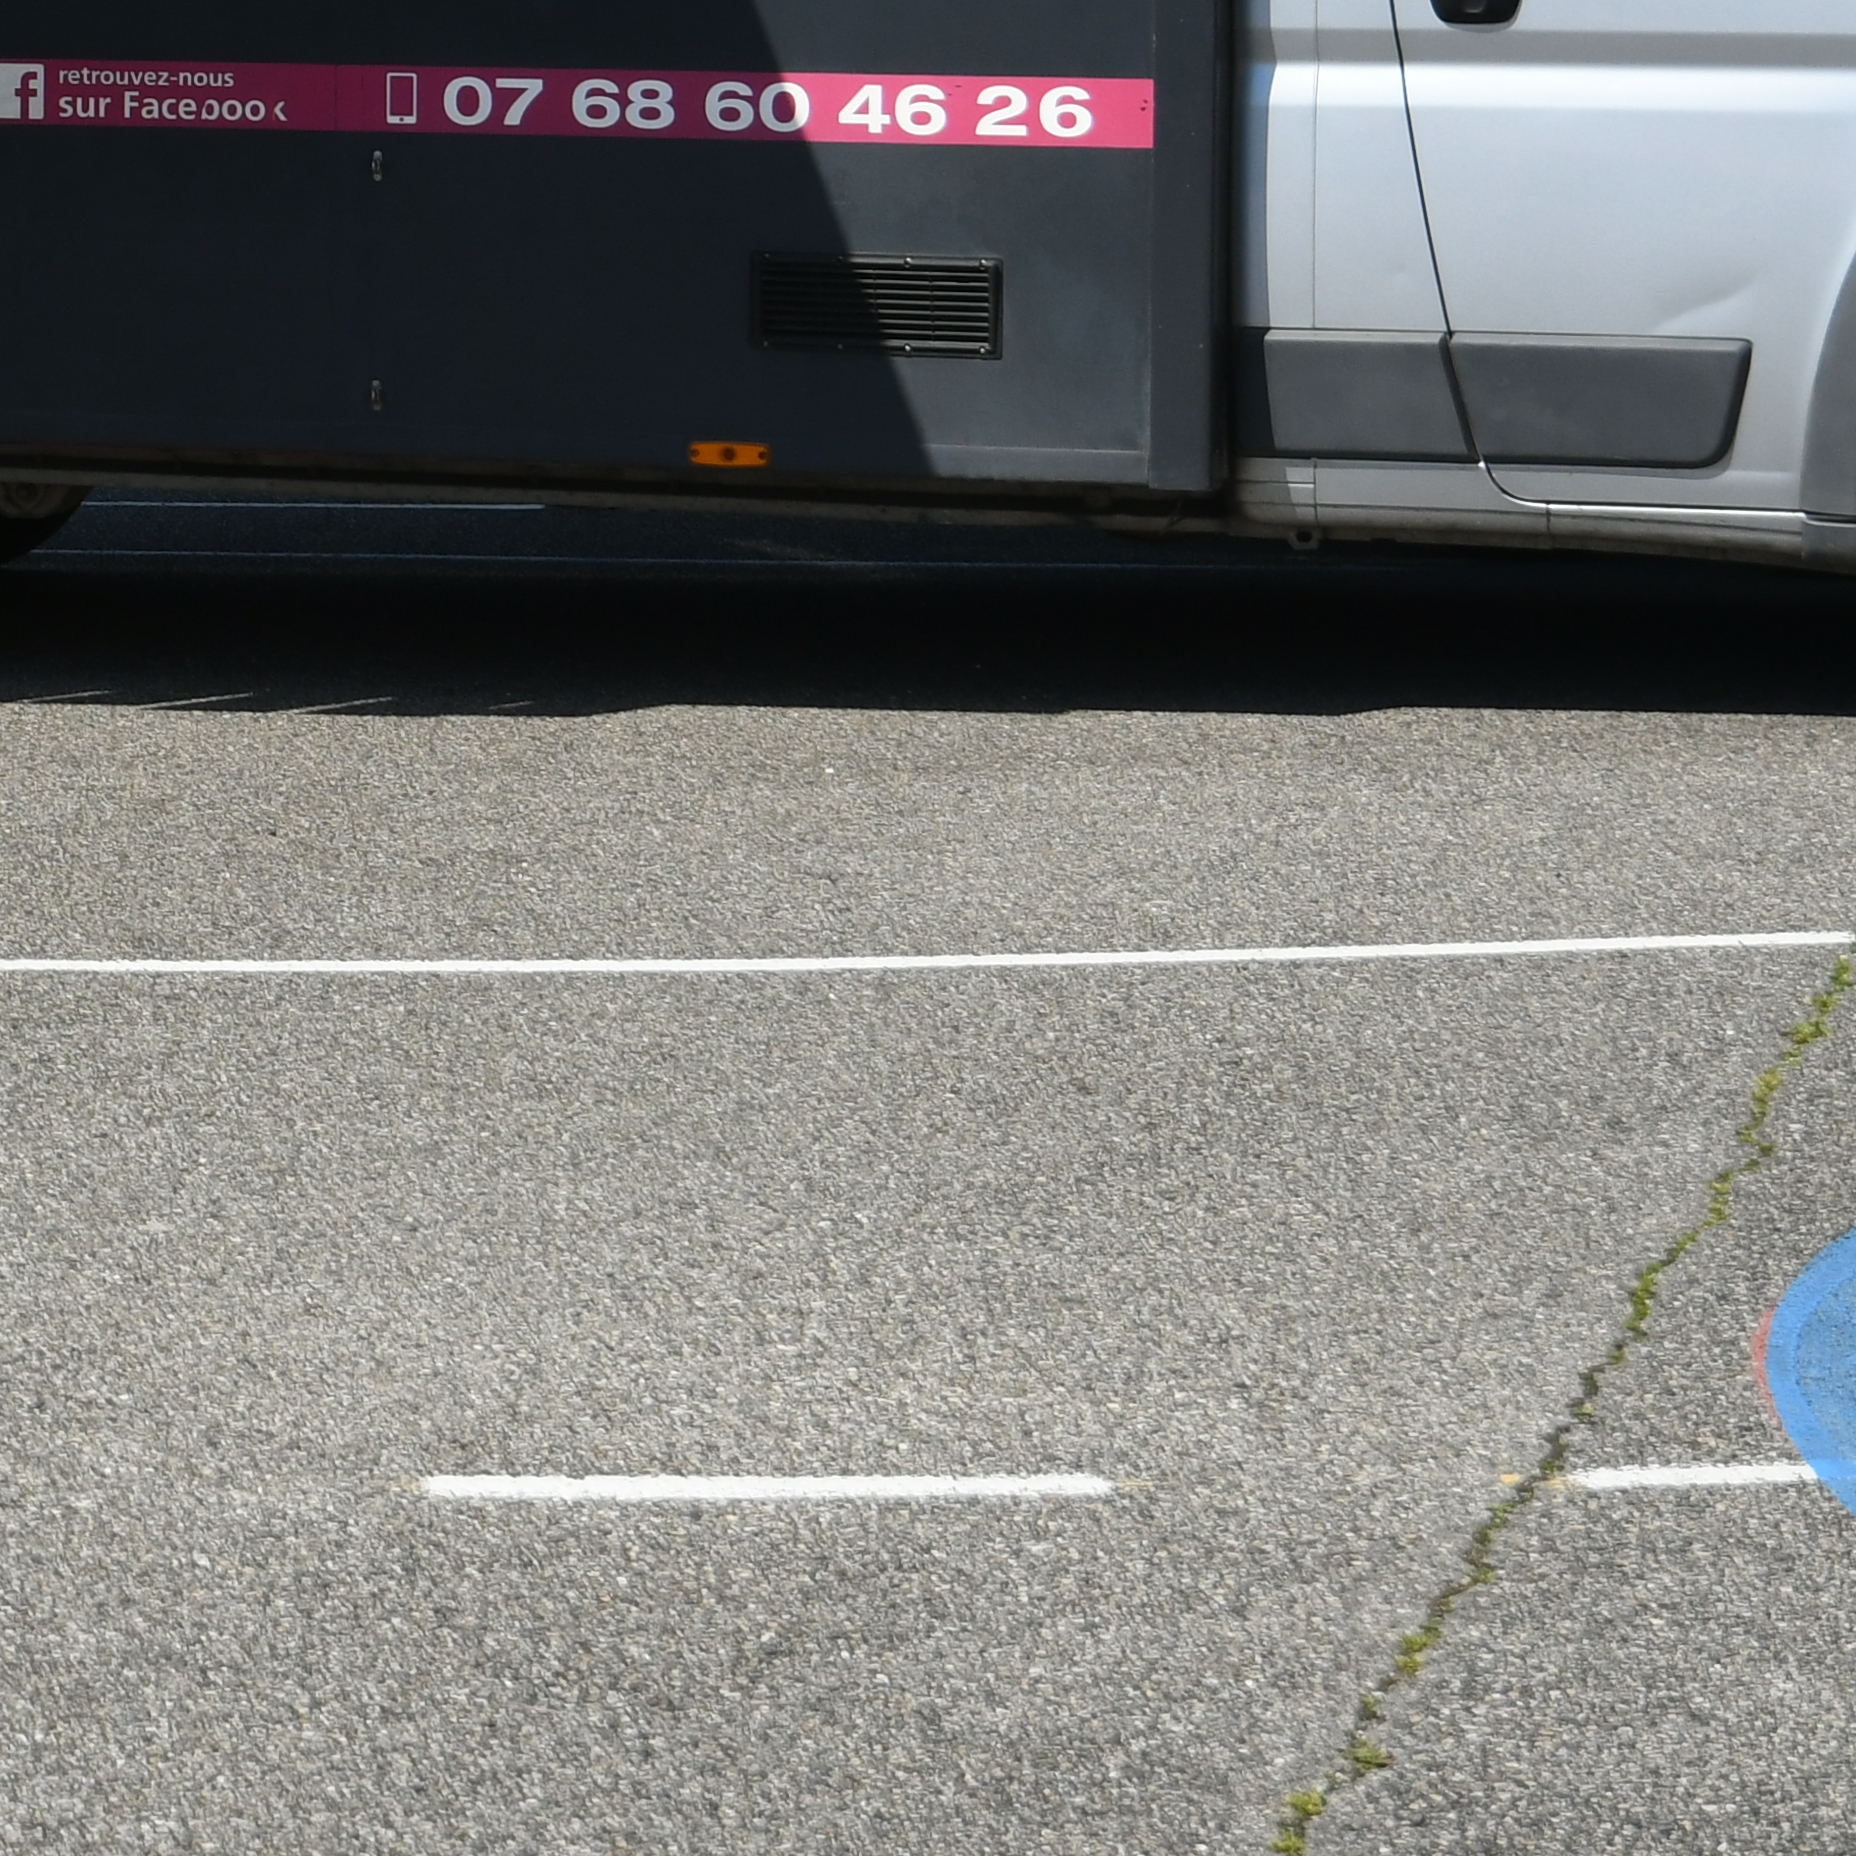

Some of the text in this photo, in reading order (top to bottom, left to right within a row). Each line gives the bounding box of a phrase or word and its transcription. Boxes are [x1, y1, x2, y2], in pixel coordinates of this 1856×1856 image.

[58, 67, 236, 88] retrouvez-nous
[58, 95, 113, 120] sur
[443, 76, 1095, 138] 07 68 60 46 26
